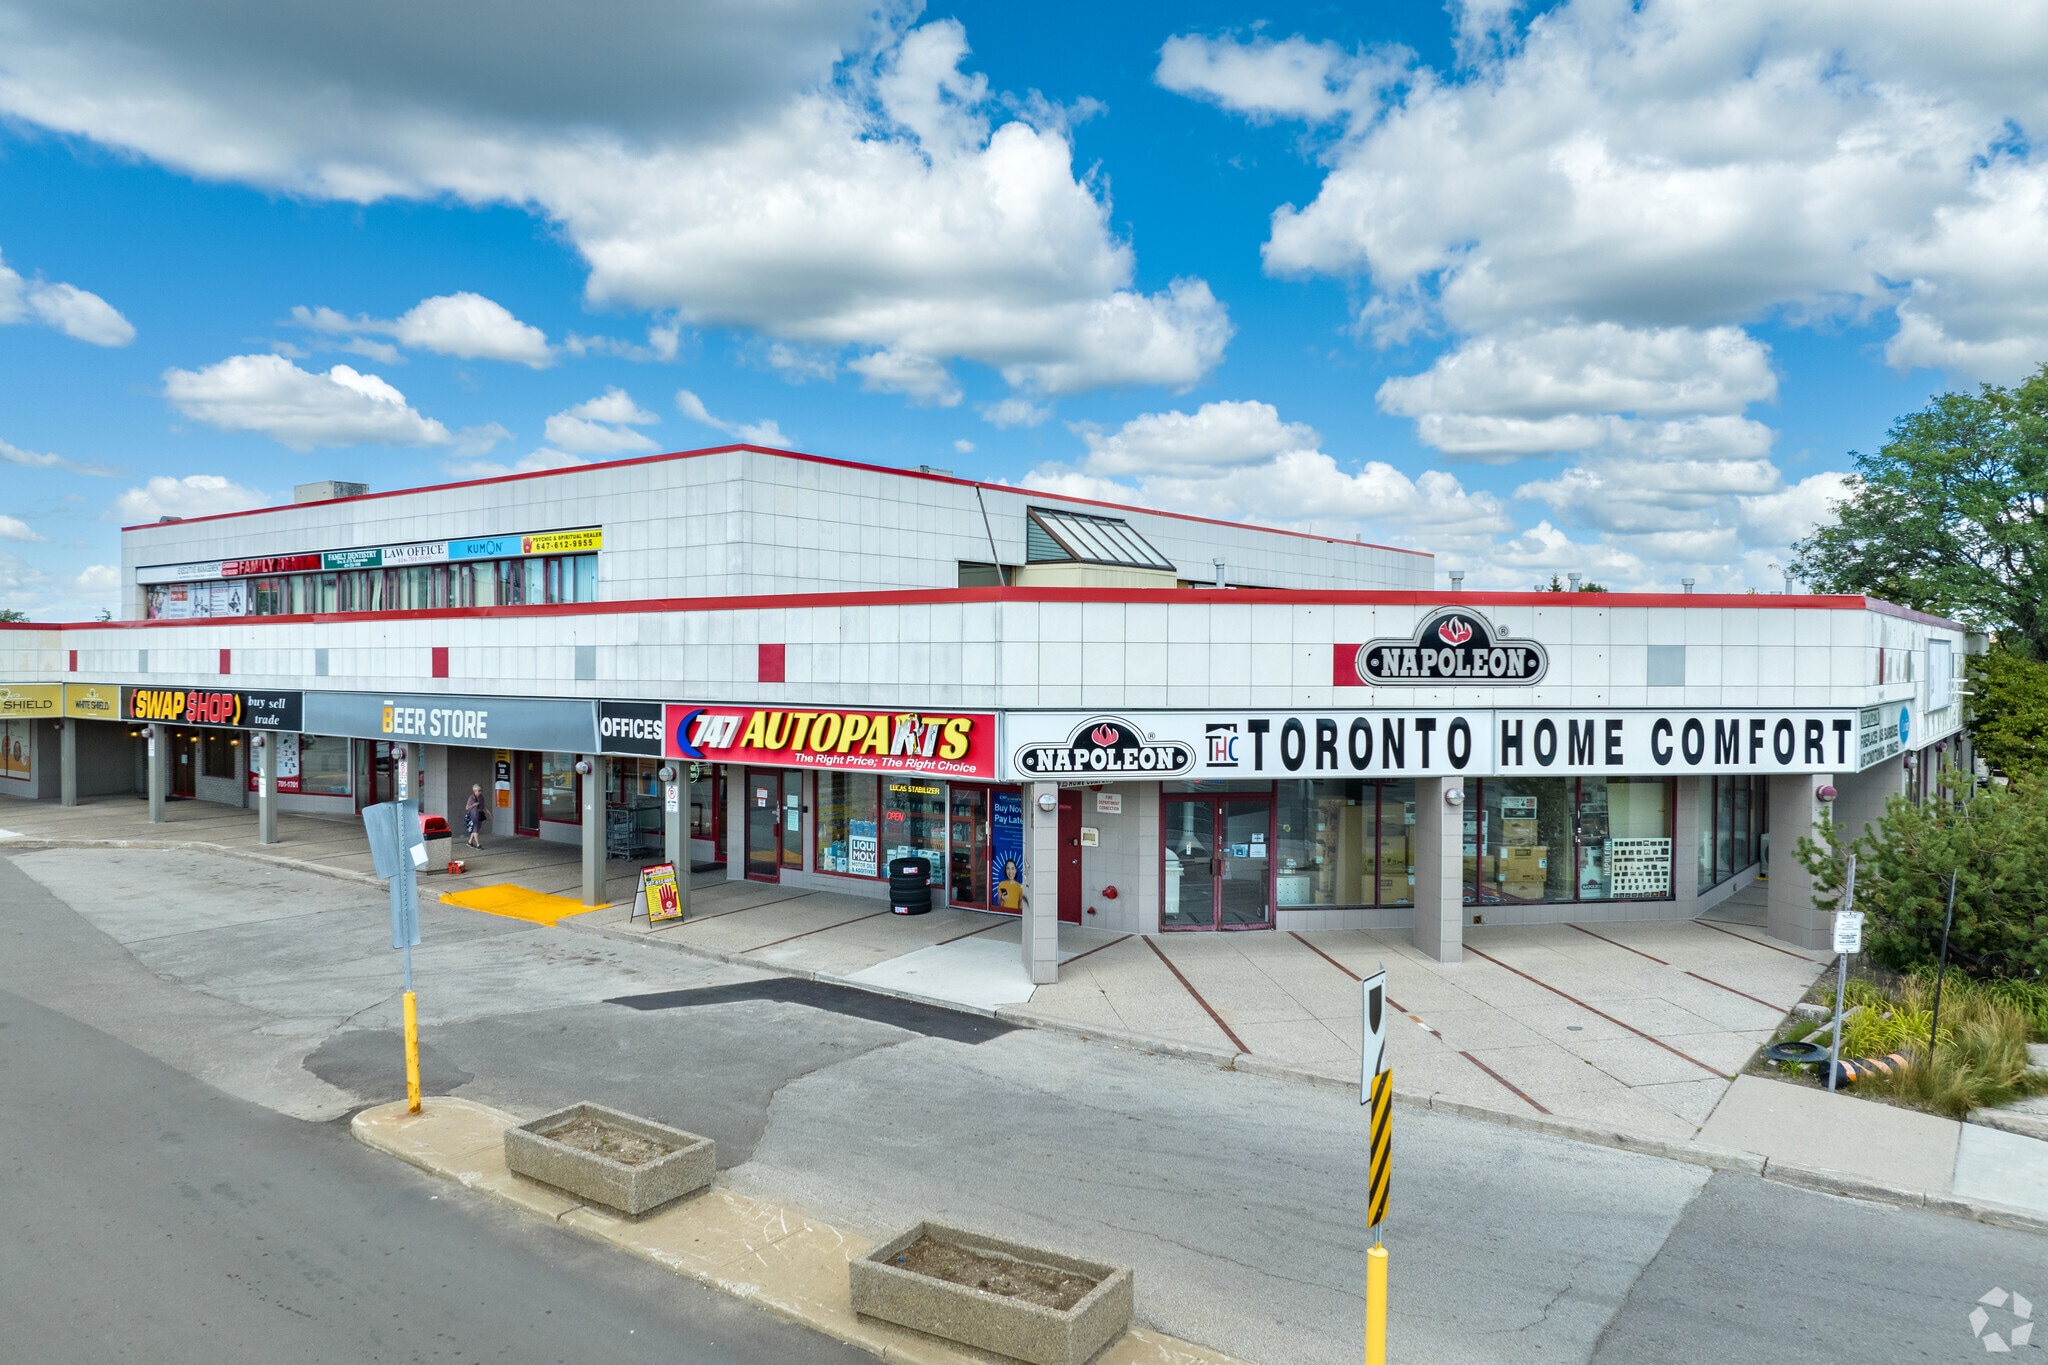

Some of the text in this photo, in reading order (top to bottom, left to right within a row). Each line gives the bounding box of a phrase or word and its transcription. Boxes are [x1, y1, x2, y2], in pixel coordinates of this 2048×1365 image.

[558, 533, 582, 541] SPIRITUAL
[384, 544, 445, 558] LAW OFFICE
[467, 540, 502, 555] KUMON
[536, 539, 593, 550] 647-612-9955
[328, 552, 347, 561] FAMILY
[239, 558, 275, 575] FAMILY
[1381, 647, 1527, 677] NAPOLEON
[3, 700, 52, 710] SHIELD
[75, 701, 110, 711] WHITE SHIELD
[136, 690, 186, 720] SWAP
[248, 696, 286, 709] buy sell
[255, 714, 280, 725] trade
[382, 706, 488, 739] BEER STORE
[601, 717, 662, 740] OFFICES
[690, 710, 972, 760] 747 AUTOPARTS
[1205, 717, 1853, 771] THC TORONTO HOME COMFORT
[795, 753, 977, 774] The Right Price; The Right Choice
[1036, 747, 1175, 772] NAPOLEON
[889, 784, 940, 795] LUCAS STABILIZER
[994, 803, 1008, 814] Buy
[886, 811, 905, 822] OPEN
[994, 814, 1008, 825] Pay
[853, 840, 875, 852] LIQUI
[853, 850, 875, 862] MOLY
[1604, 841, 1612, 876] NAPOLEON
